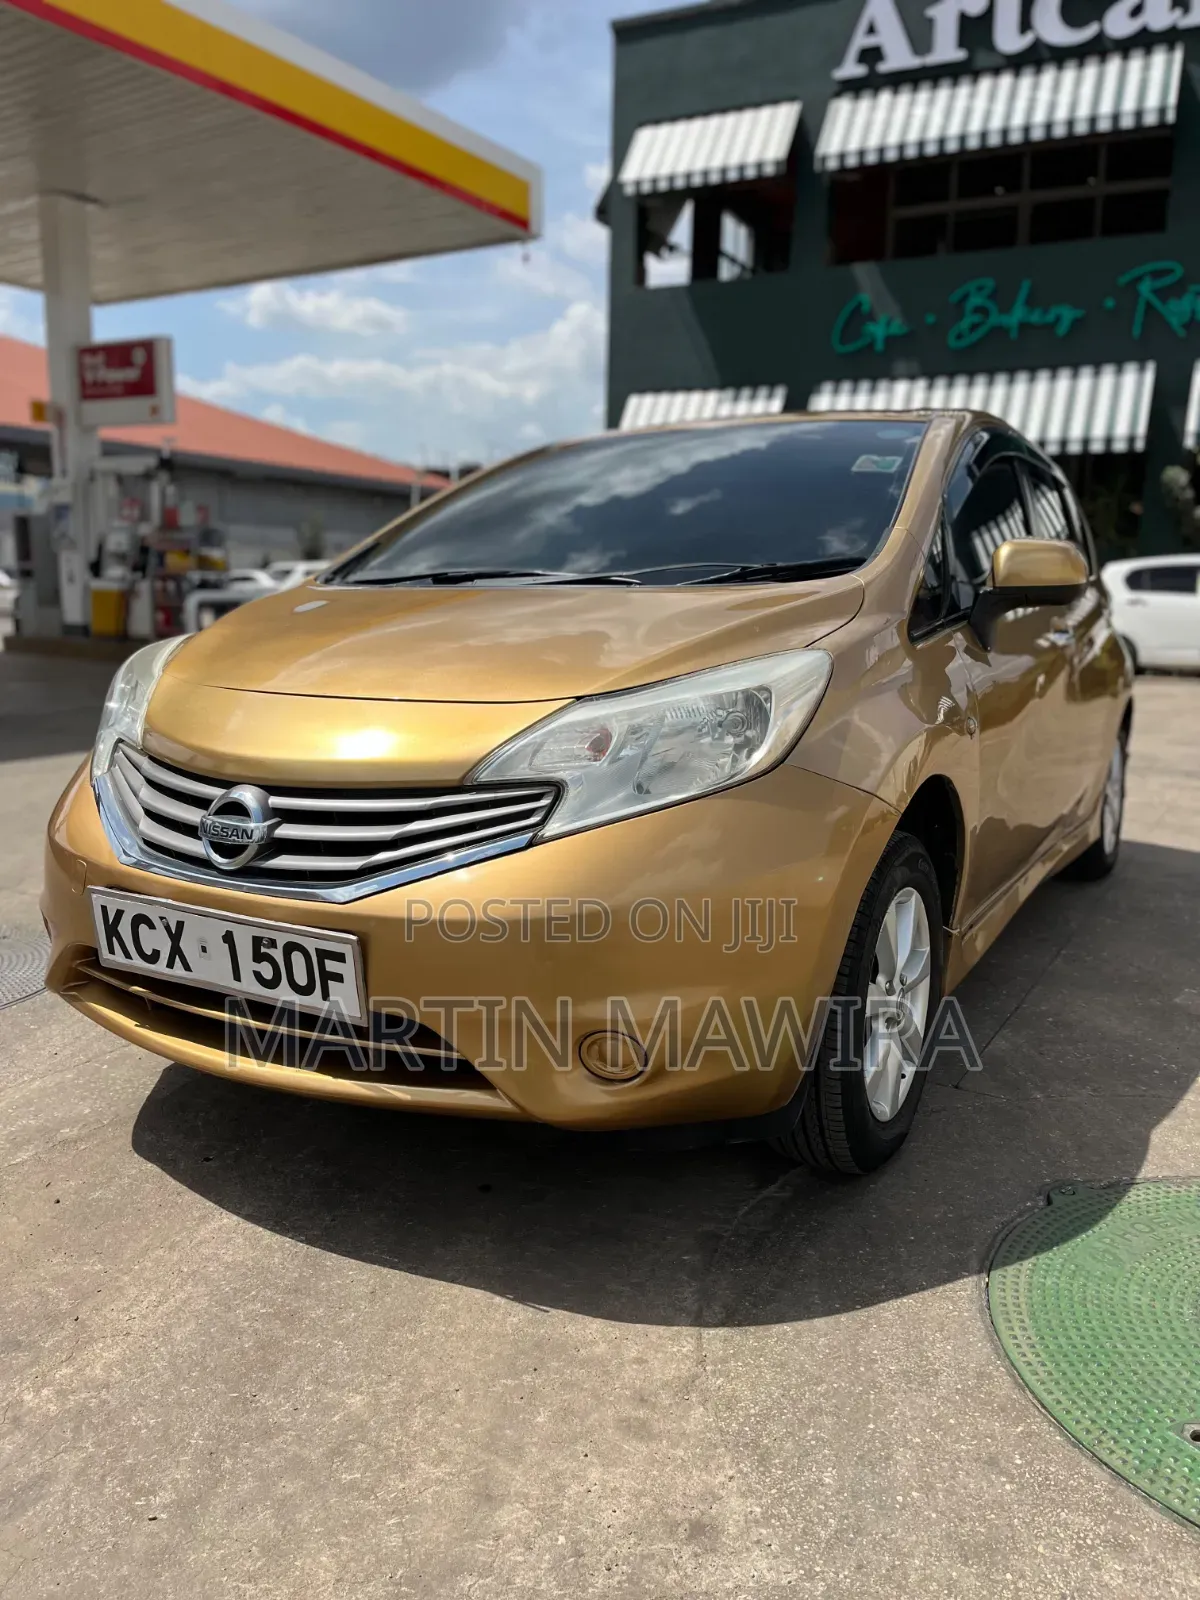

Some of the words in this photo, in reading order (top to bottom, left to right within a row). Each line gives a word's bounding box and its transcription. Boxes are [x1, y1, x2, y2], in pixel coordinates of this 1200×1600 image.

[201, 821, 254, 840] NISSAN
[100, 904, 194, 974] KCX
[221, 928, 347, 1002] 150F
